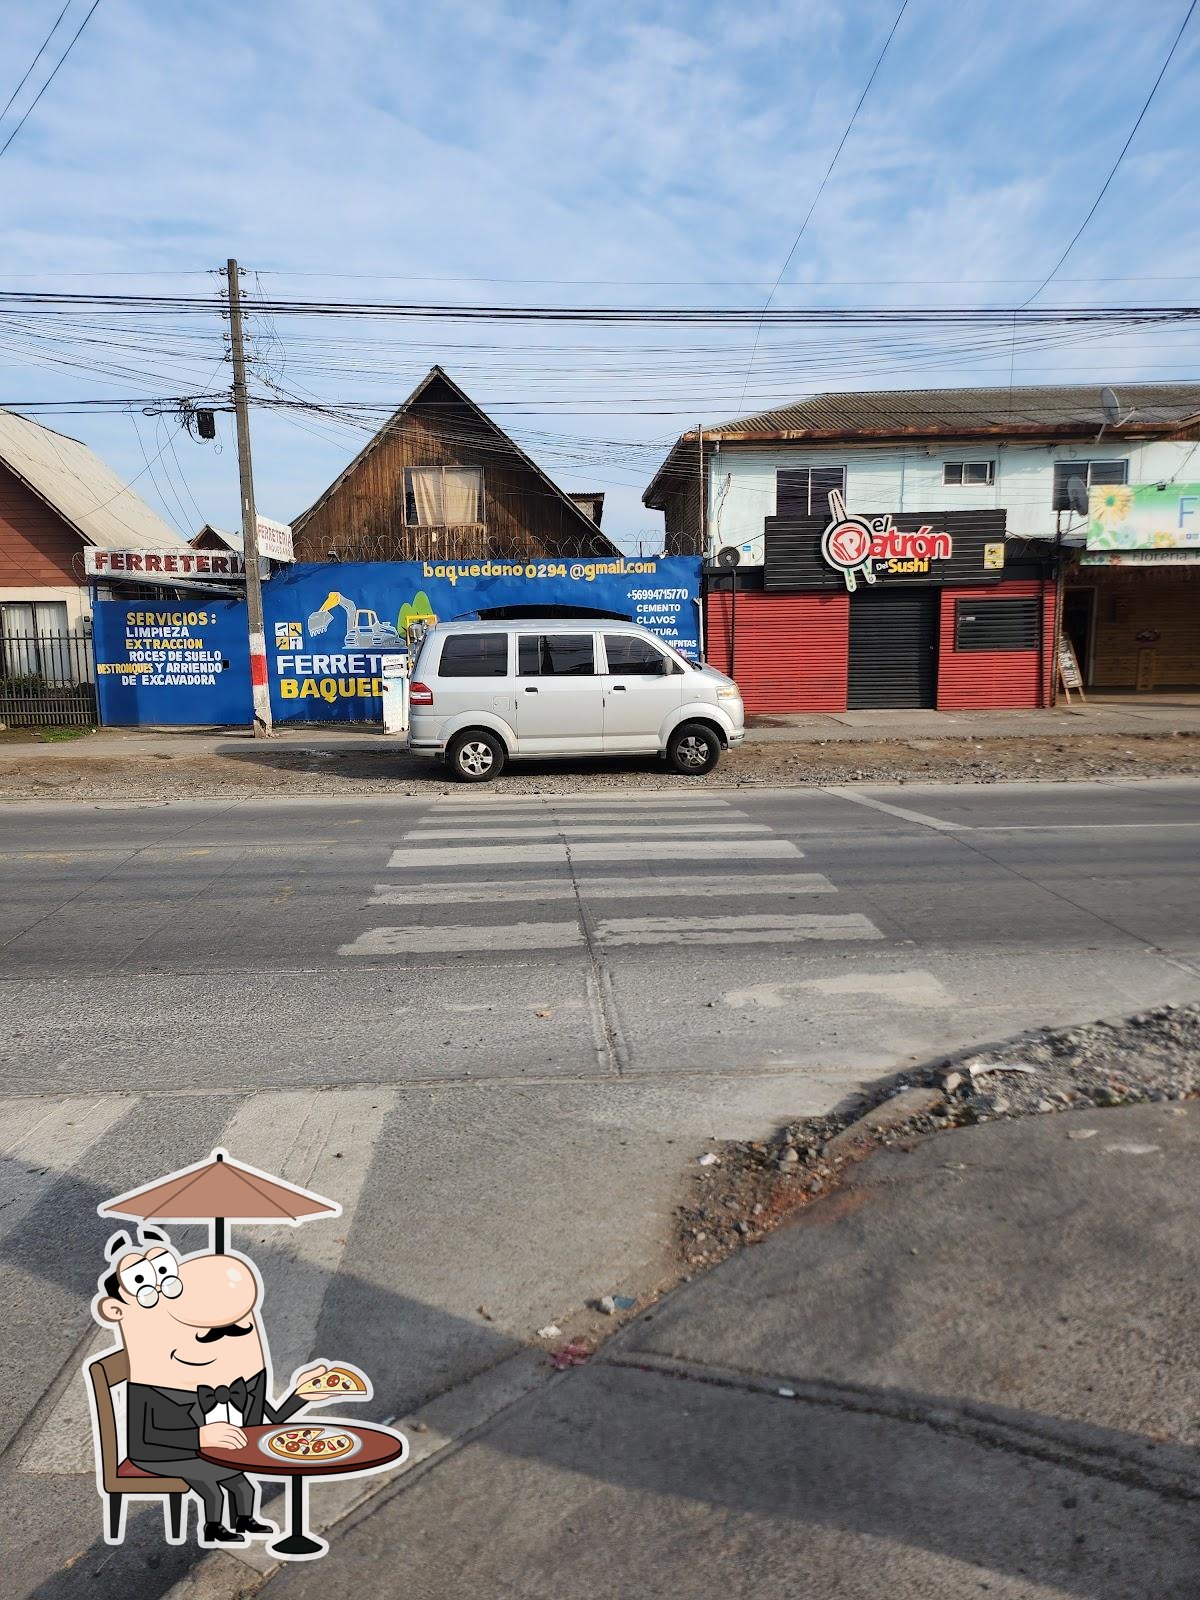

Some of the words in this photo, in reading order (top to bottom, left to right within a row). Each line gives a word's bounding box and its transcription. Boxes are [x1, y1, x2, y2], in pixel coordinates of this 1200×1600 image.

[872, 515, 892, 533] el
[837, 526, 950, 560] Patrón
[875, 561, 889, 571] Del
[888, 557, 929, 573] Sushi
[636, 603, 681, 612] CEMENTO
[636, 615, 676, 624] CLAVOS
[126, 626, 190, 638] LIMPIEZA
[126, 638, 203, 650] EXTRACCION
[129, 650, 167, 662] ROCES
[168, 650, 183, 662] DE
[184, 650, 222, 662] SUELO
[96, 663, 154, 675] DESTRONQUES
[154, 663, 165, 674] Y
[166, 662, 223, 674] ARRIENDO
[276, 653, 383, 675] FERRET
[122, 674, 137, 686] DE
[141, 674, 216, 686] EXCAVADORA
[280, 677, 384, 704] BAQUED
